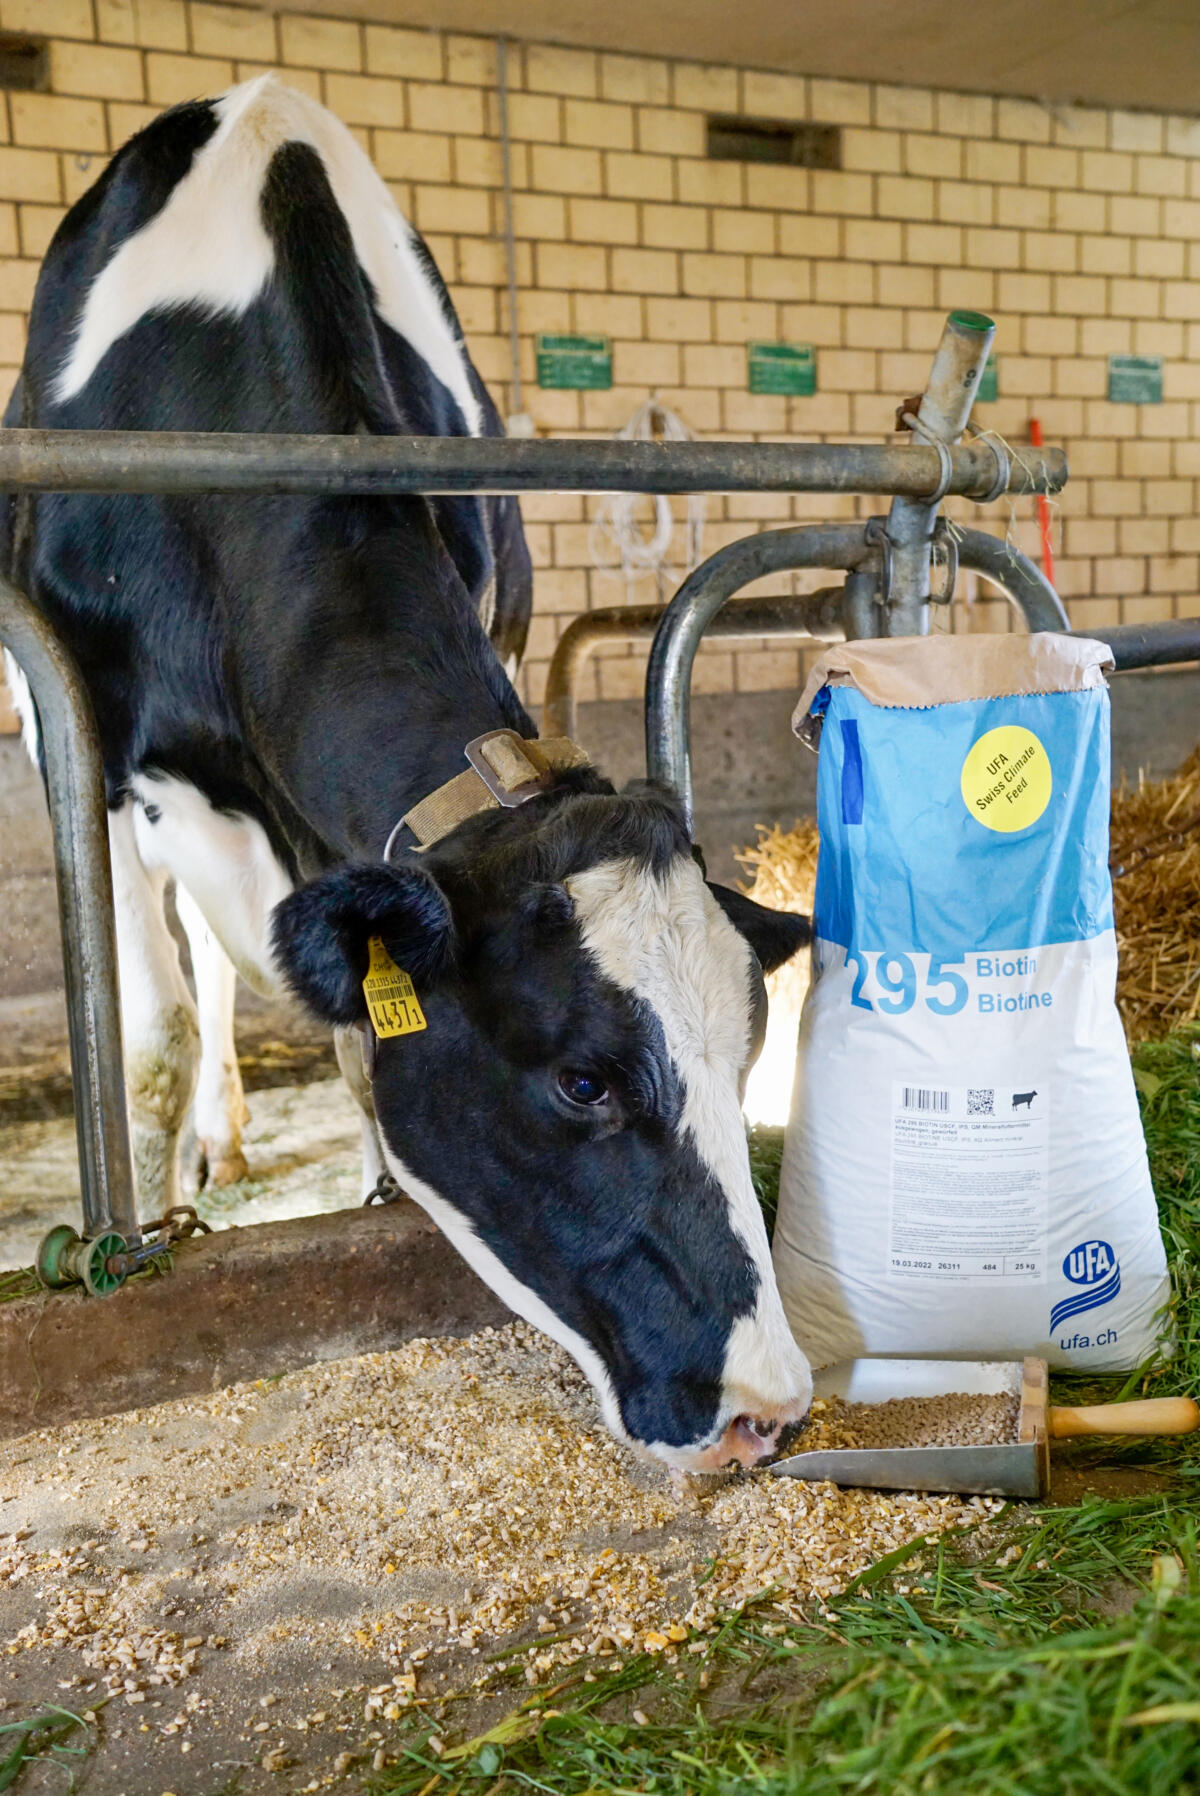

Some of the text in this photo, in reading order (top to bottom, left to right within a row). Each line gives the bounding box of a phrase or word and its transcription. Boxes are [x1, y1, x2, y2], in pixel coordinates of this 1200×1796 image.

[986, 753, 1009, 775] UFA
[976, 746, 1036, 810] Swiss Climate
[1005, 777, 1028, 804] Feed
[976, 956, 1037, 977] Biotin
[844, 950, 969, 1015] 295
[978, 992, 1053, 1013] Biotine
[891, 1259, 932, 1269] 19.03.2022
[938, 1262, 961, 1270] 26311
[1025, 1263, 1036, 1271] kg
[1069, 1241, 1111, 1282] UFA
[1060, 1329, 1118, 1350] ufa.ch
